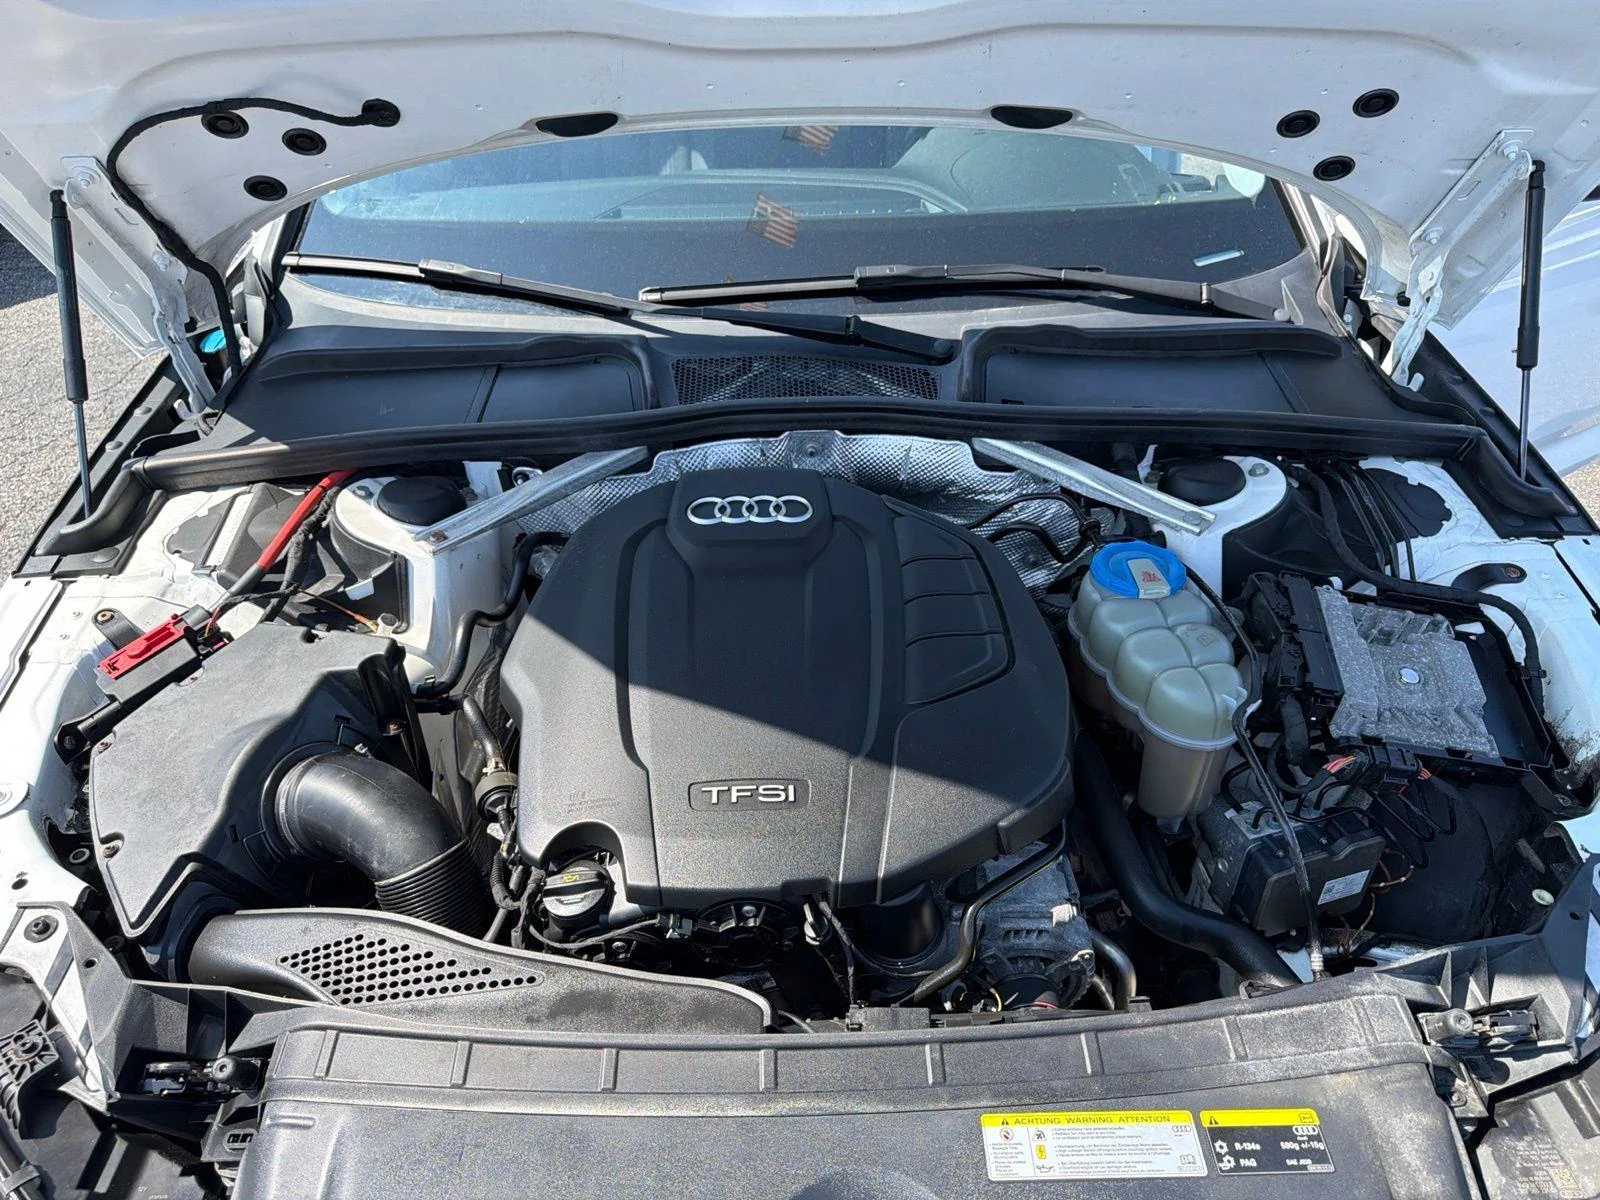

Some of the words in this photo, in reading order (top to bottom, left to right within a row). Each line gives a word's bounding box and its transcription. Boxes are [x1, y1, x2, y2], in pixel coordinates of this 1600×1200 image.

[701, 784, 797, 805] TFSI
[1014, 1117, 1061, 1125] ACHTUNG
[1065, 1116, 1113, 1124] WARNING
[1118, 1115, 1170, 1123] ATTENTION
[1240, 1158, 1257, 1167] PAG
